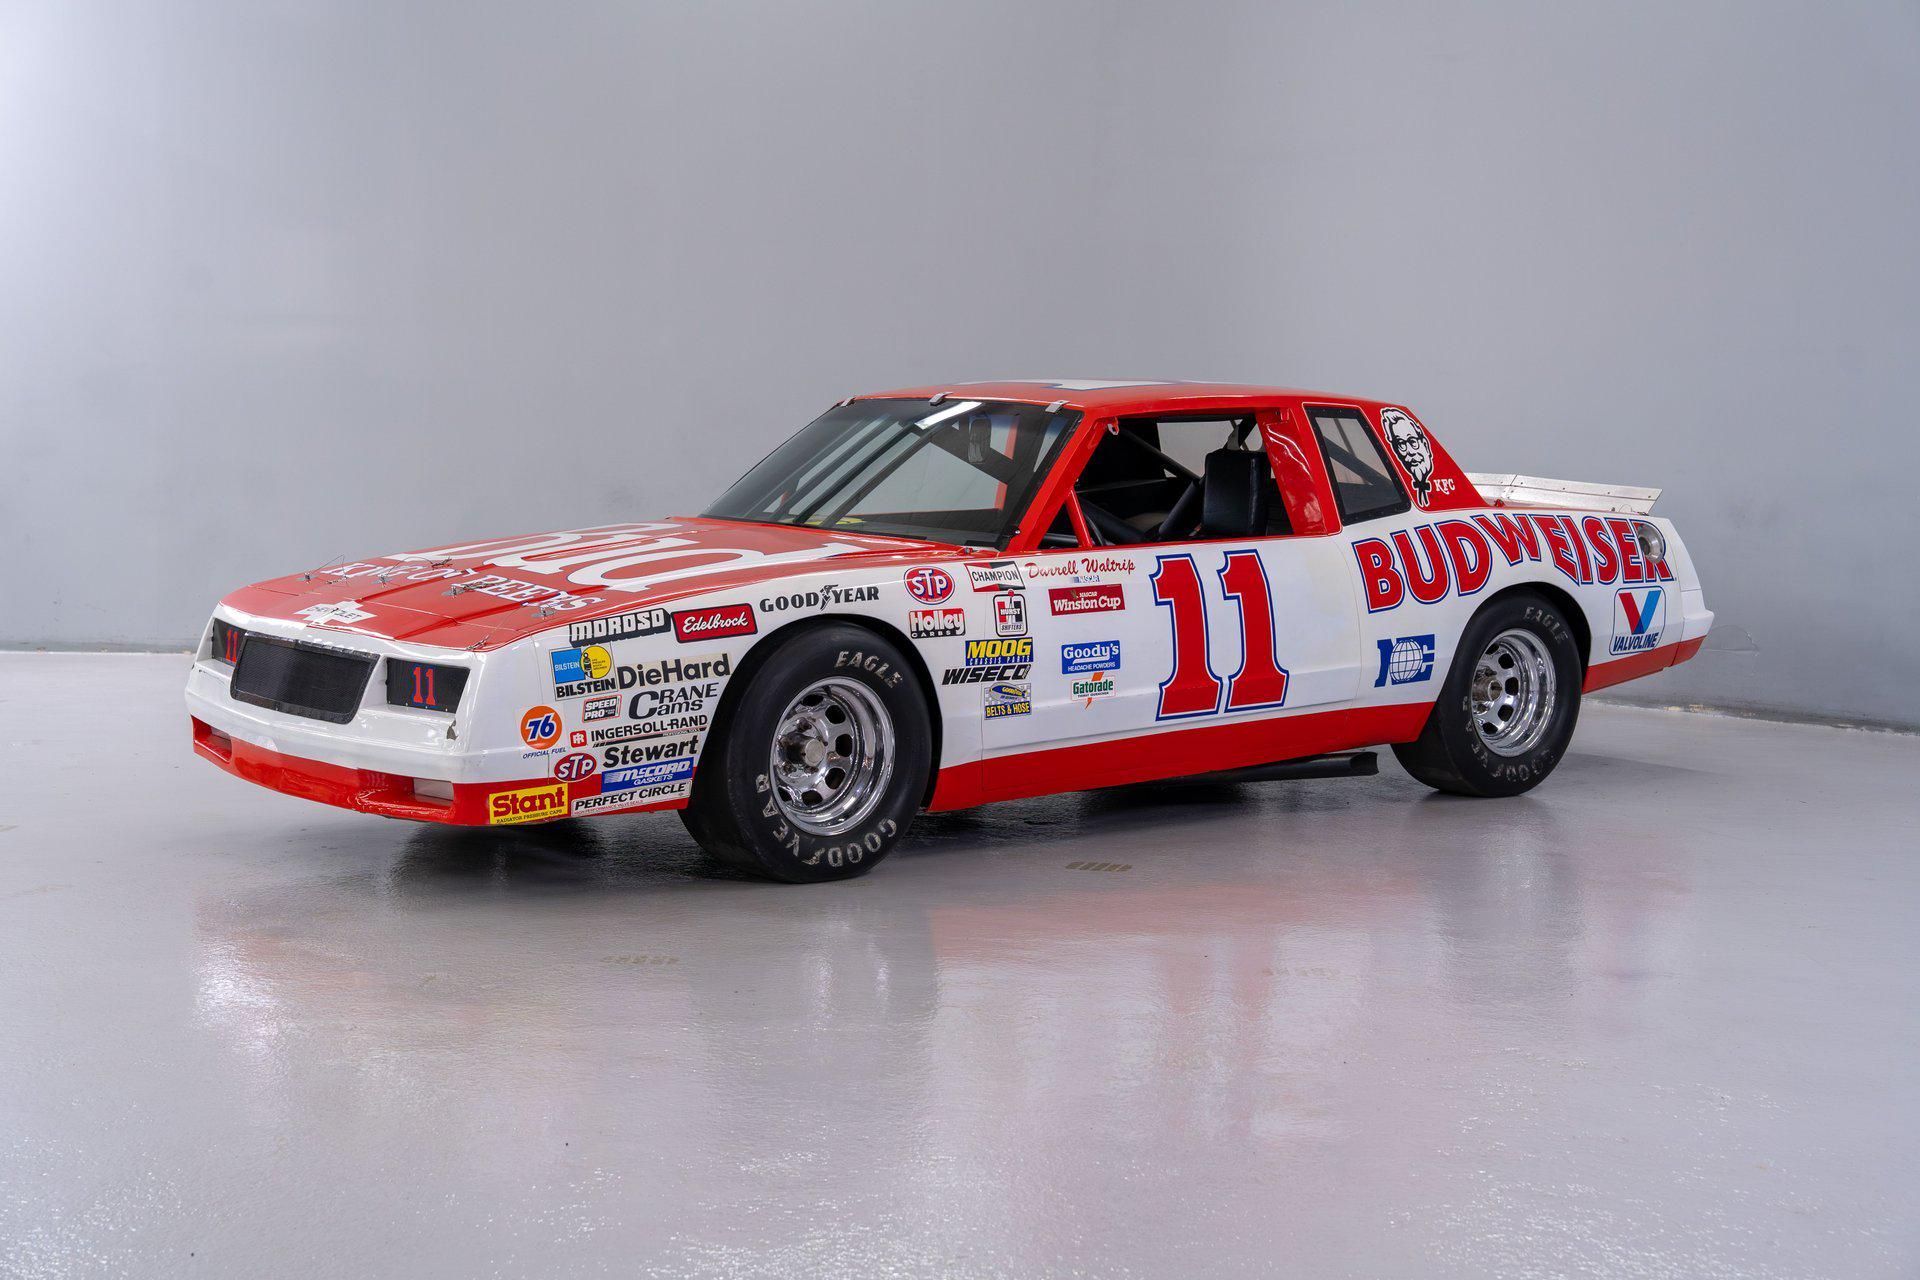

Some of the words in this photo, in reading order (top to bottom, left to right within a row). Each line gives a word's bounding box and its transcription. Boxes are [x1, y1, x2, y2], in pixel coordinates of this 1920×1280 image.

[1433, 478, 1456, 495] KFC
[1025, 560, 1079, 579] Darrell
[1081, 557, 1136, 575] Waltrip
[1351, 513, 1675, 614] BUDWEISER
[911, 569, 948, 598] STP
[971, 569, 1020, 582] CHAMPION
[760, 584, 880, 612] GOODYEAR
[1053, 597, 1098, 612] Winston
[1098, 595, 1121, 610] Cup
[682, 610, 749, 634] Edelbrock
[910, 610, 965, 635] Holley
[1000, 607, 1021, 616] HURST
[570, 608, 669, 645] MOROSO
[911, 630, 951, 638] CARBS
[1001, 623, 1022, 631] SHIFTERS
[1149, 549, 1289, 721] 11
[224, 628, 239, 663] 11
[967, 638, 1033, 658] MOOG
[1612, 632, 1660, 652] VALVOLINE
[969, 657, 1002, 665] CHASSIS
[1006, 655, 1030, 663] PARTS
[1063, 642, 1120, 665] Goody's
[554, 662, 580, 672] BILSTEIN
[617, 653, 731, 689] DieHard
[834, 651, 904, 689] EAGLE
[942, 664, 1031, 685] WISECO
[412, 664, 436, 707] 11
[556, 678, 617, 698] BILSTEIN
[1073, 679, 1114, 695] Gatorade
[584, 709, 605, 720] PRO
[585, 698, 617, 711] SPEED
[986, 704, 1006, 716] BELTS
[1007, 704, 1012, 715] &
[1013, 702, 1030, 714] HOSE
[526, 713, 556, 742] 76
[590, 714, 708, 742] INGERSOLL-RAND
[522, 750, 549, 760] OFFICIAL
[551, 747, 567, 755] FUEL
[603, 735, 699, 769] Stewart
[558, 754, 594, 781] STP
[633, 773, 673, 786] GASKETS
[492, 786, 565, 818] Stant
[574, 790, 638, 811] PERFECT
[638, 782, 687, 799] CIRCLE
